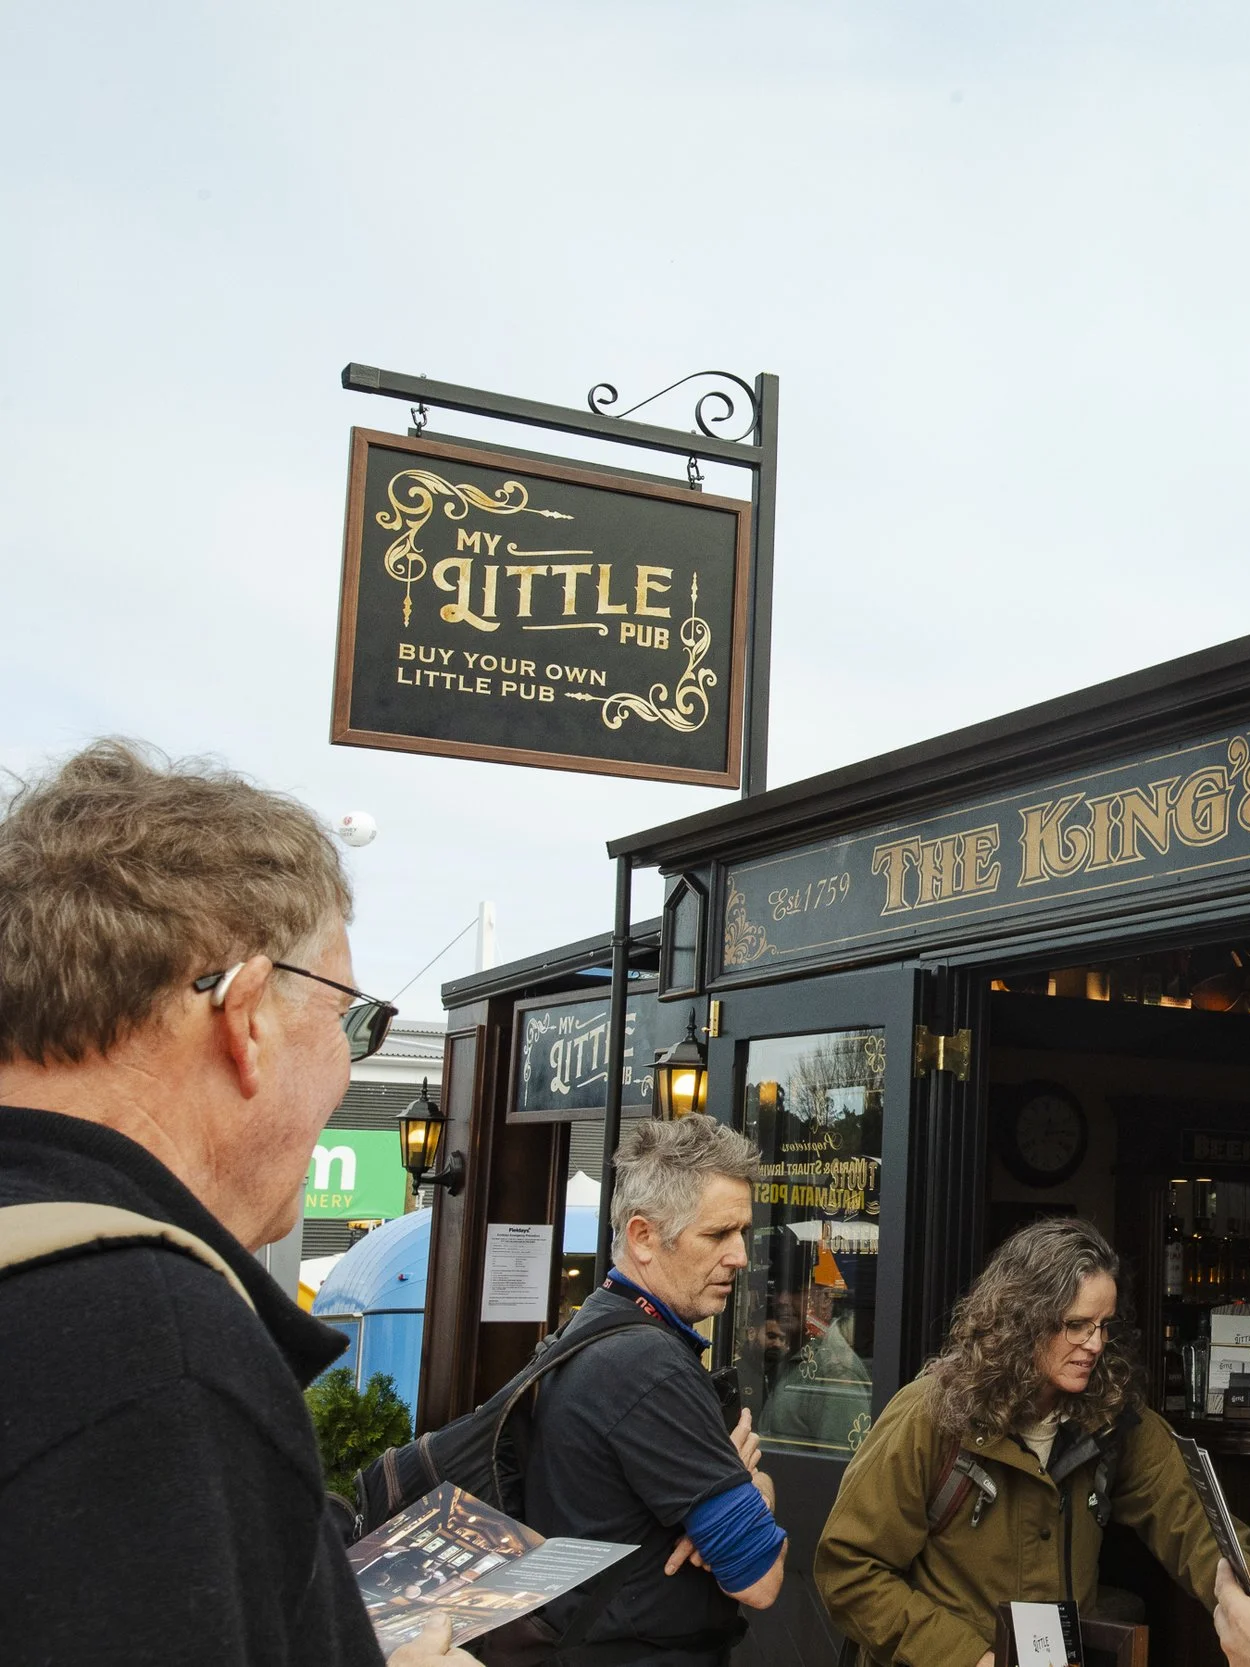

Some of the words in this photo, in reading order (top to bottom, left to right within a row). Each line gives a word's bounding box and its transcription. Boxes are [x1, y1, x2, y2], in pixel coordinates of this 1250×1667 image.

[457, 528, 502, 556] MY
[432, 557, 673, 632] LITTLE
[620, 622, 670, 650] PUB
[398, 643, 454, 665] BUY
[464, 653, 537, 677] YOUR
[545, 665, 607, 687] OWN
[396, 667, 491, 695] LITTLE
[501, 683, 556, 702] PUB
[871, 823, 1001, 917] THE
[803, 871, 851, 912] 1759
[559, 1016, 574, 1035] MY
